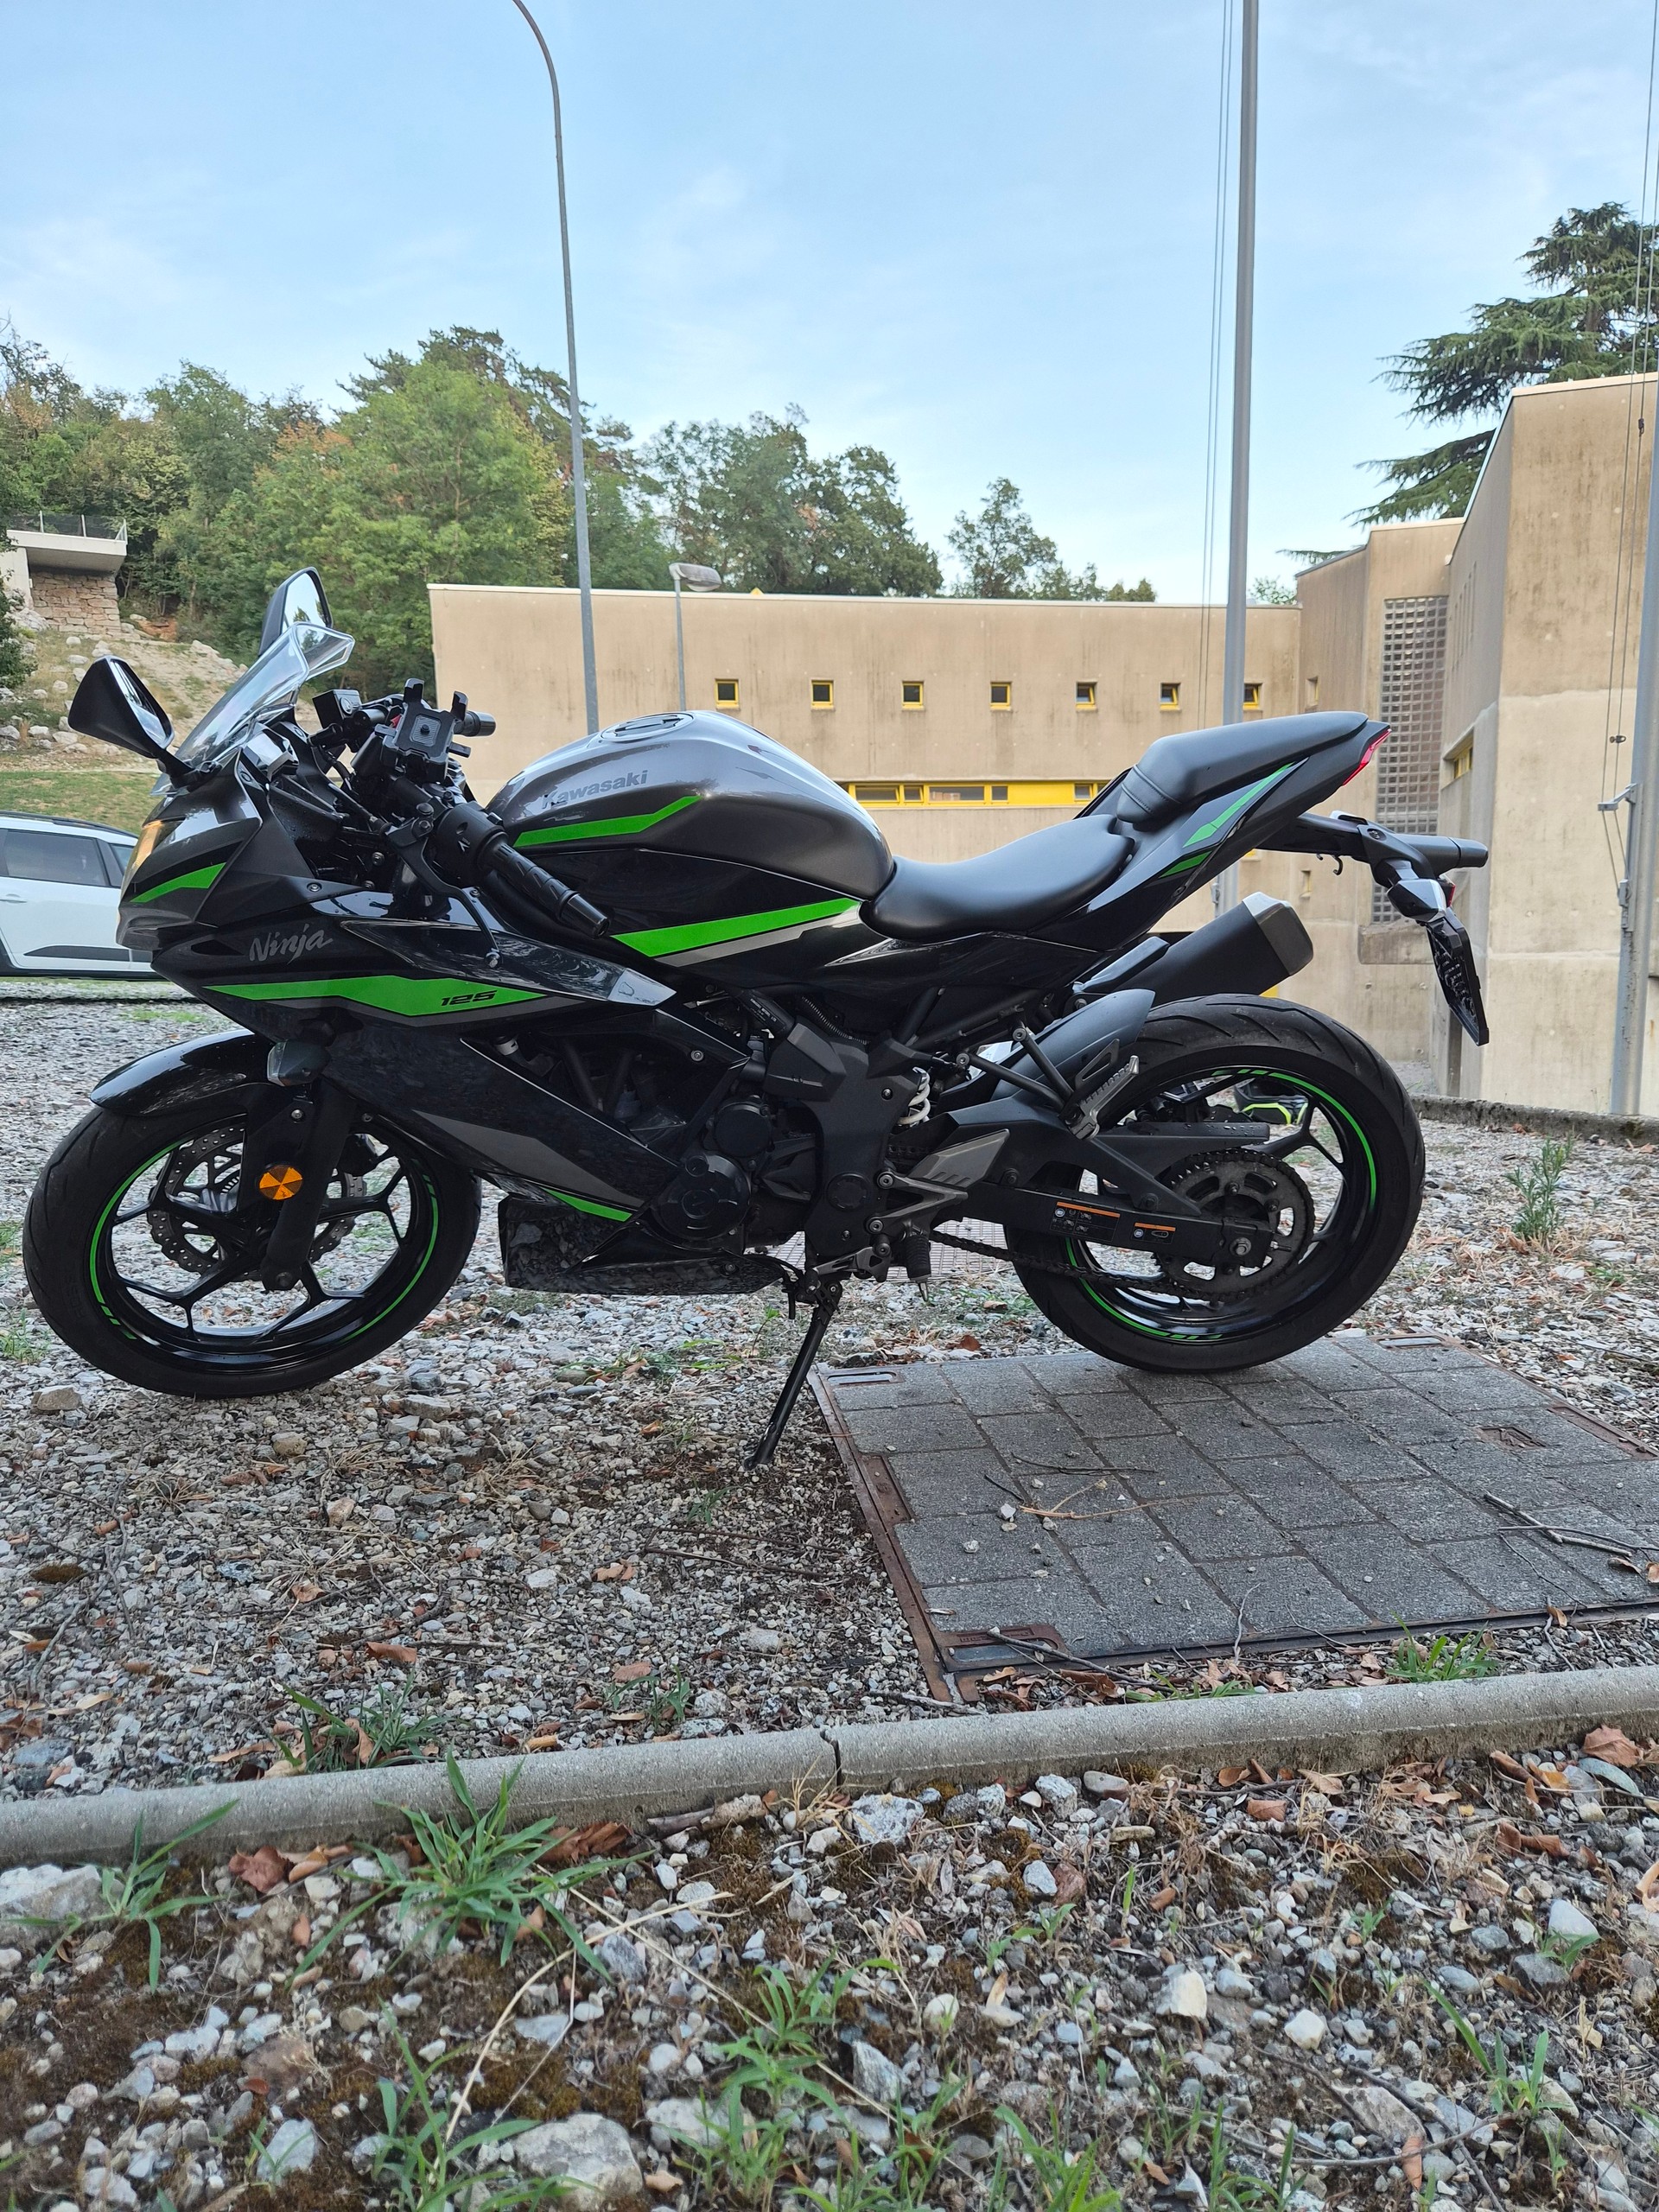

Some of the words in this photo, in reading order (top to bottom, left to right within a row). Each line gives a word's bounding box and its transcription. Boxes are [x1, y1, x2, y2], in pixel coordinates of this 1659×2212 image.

[542, 770, 648, 810] Kawasaki
[249, 924, 334, 965] Ninja
[441, 990, 497, 1007] 125
